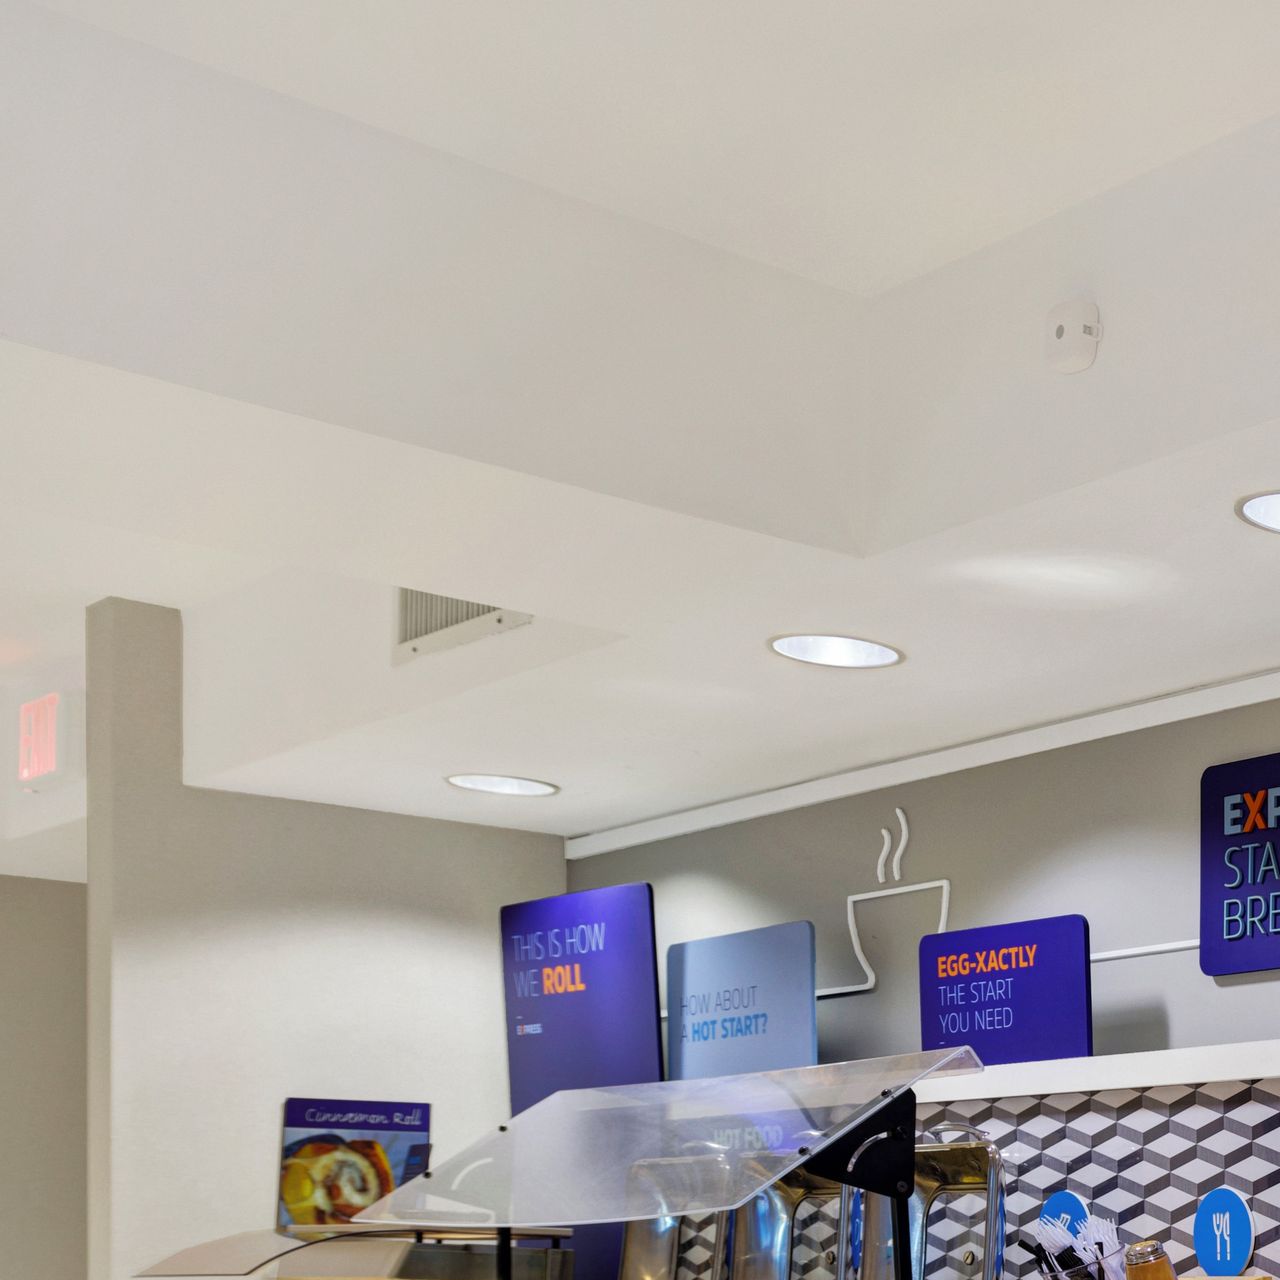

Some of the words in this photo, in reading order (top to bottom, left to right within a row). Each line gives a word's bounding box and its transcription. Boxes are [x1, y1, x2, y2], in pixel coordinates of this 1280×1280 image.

[511, 931, 545, 962] THIS
[548, 929, 562, 958] IS
[565, 922, 606, 955] HOW
[937, 944, 1037, 979] EGG-XACTLY
[513, 969, 540, 998] WE
[542, 963, 586, 995] ROLL
[938, 984, 966, 1006] THE
[970, 978, 1014, 1003] START
[680, 991, 711, 1018] HOW
[714, 985, 758, 1014] ABOUT
[680, 1023, 689, 1043] A
[692, 1019, 717, 1043] HOT
[721, 1012, 768, 1040] START?
[939, 1012, 969, 1034] YOU
[975, 1007, 1014, 1031] NEED
